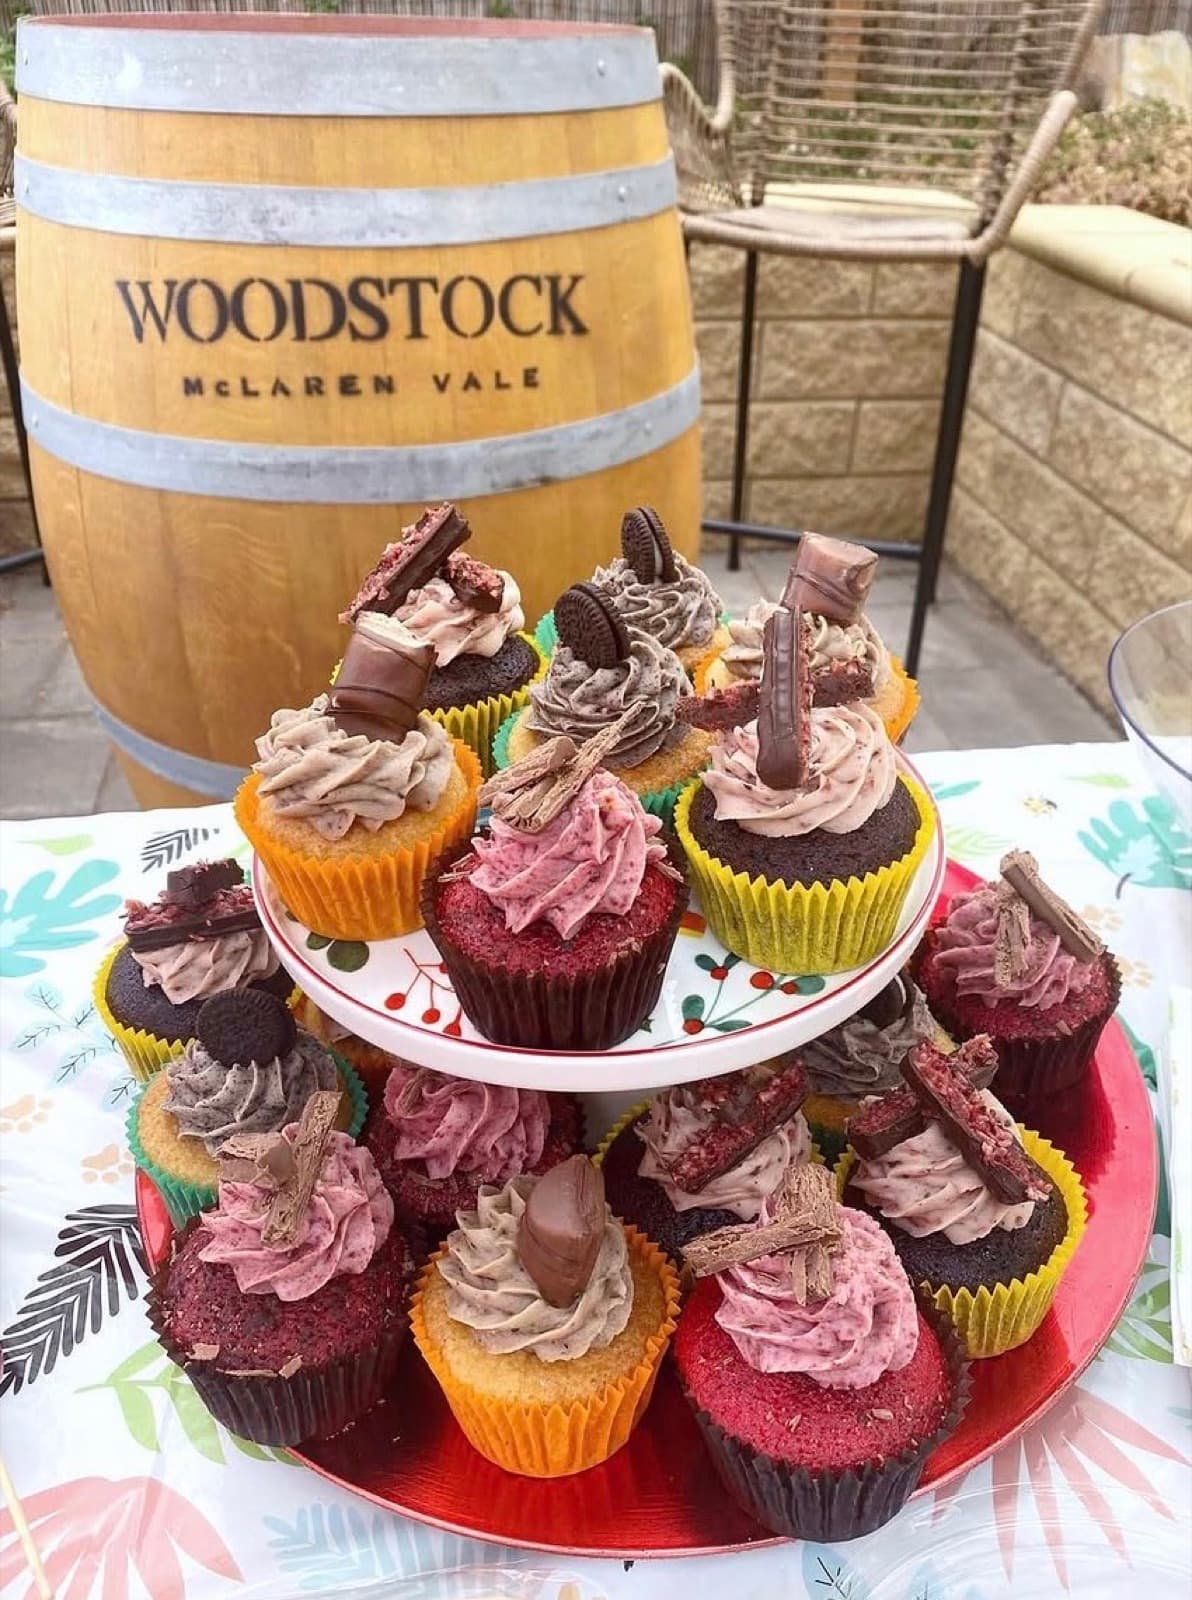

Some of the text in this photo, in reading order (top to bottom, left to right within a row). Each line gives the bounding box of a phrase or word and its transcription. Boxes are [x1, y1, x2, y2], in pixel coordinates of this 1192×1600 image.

[115, 274, 590, 344] WOODSTOCK
[183, 367, 540, 397] McLAREN VALE
